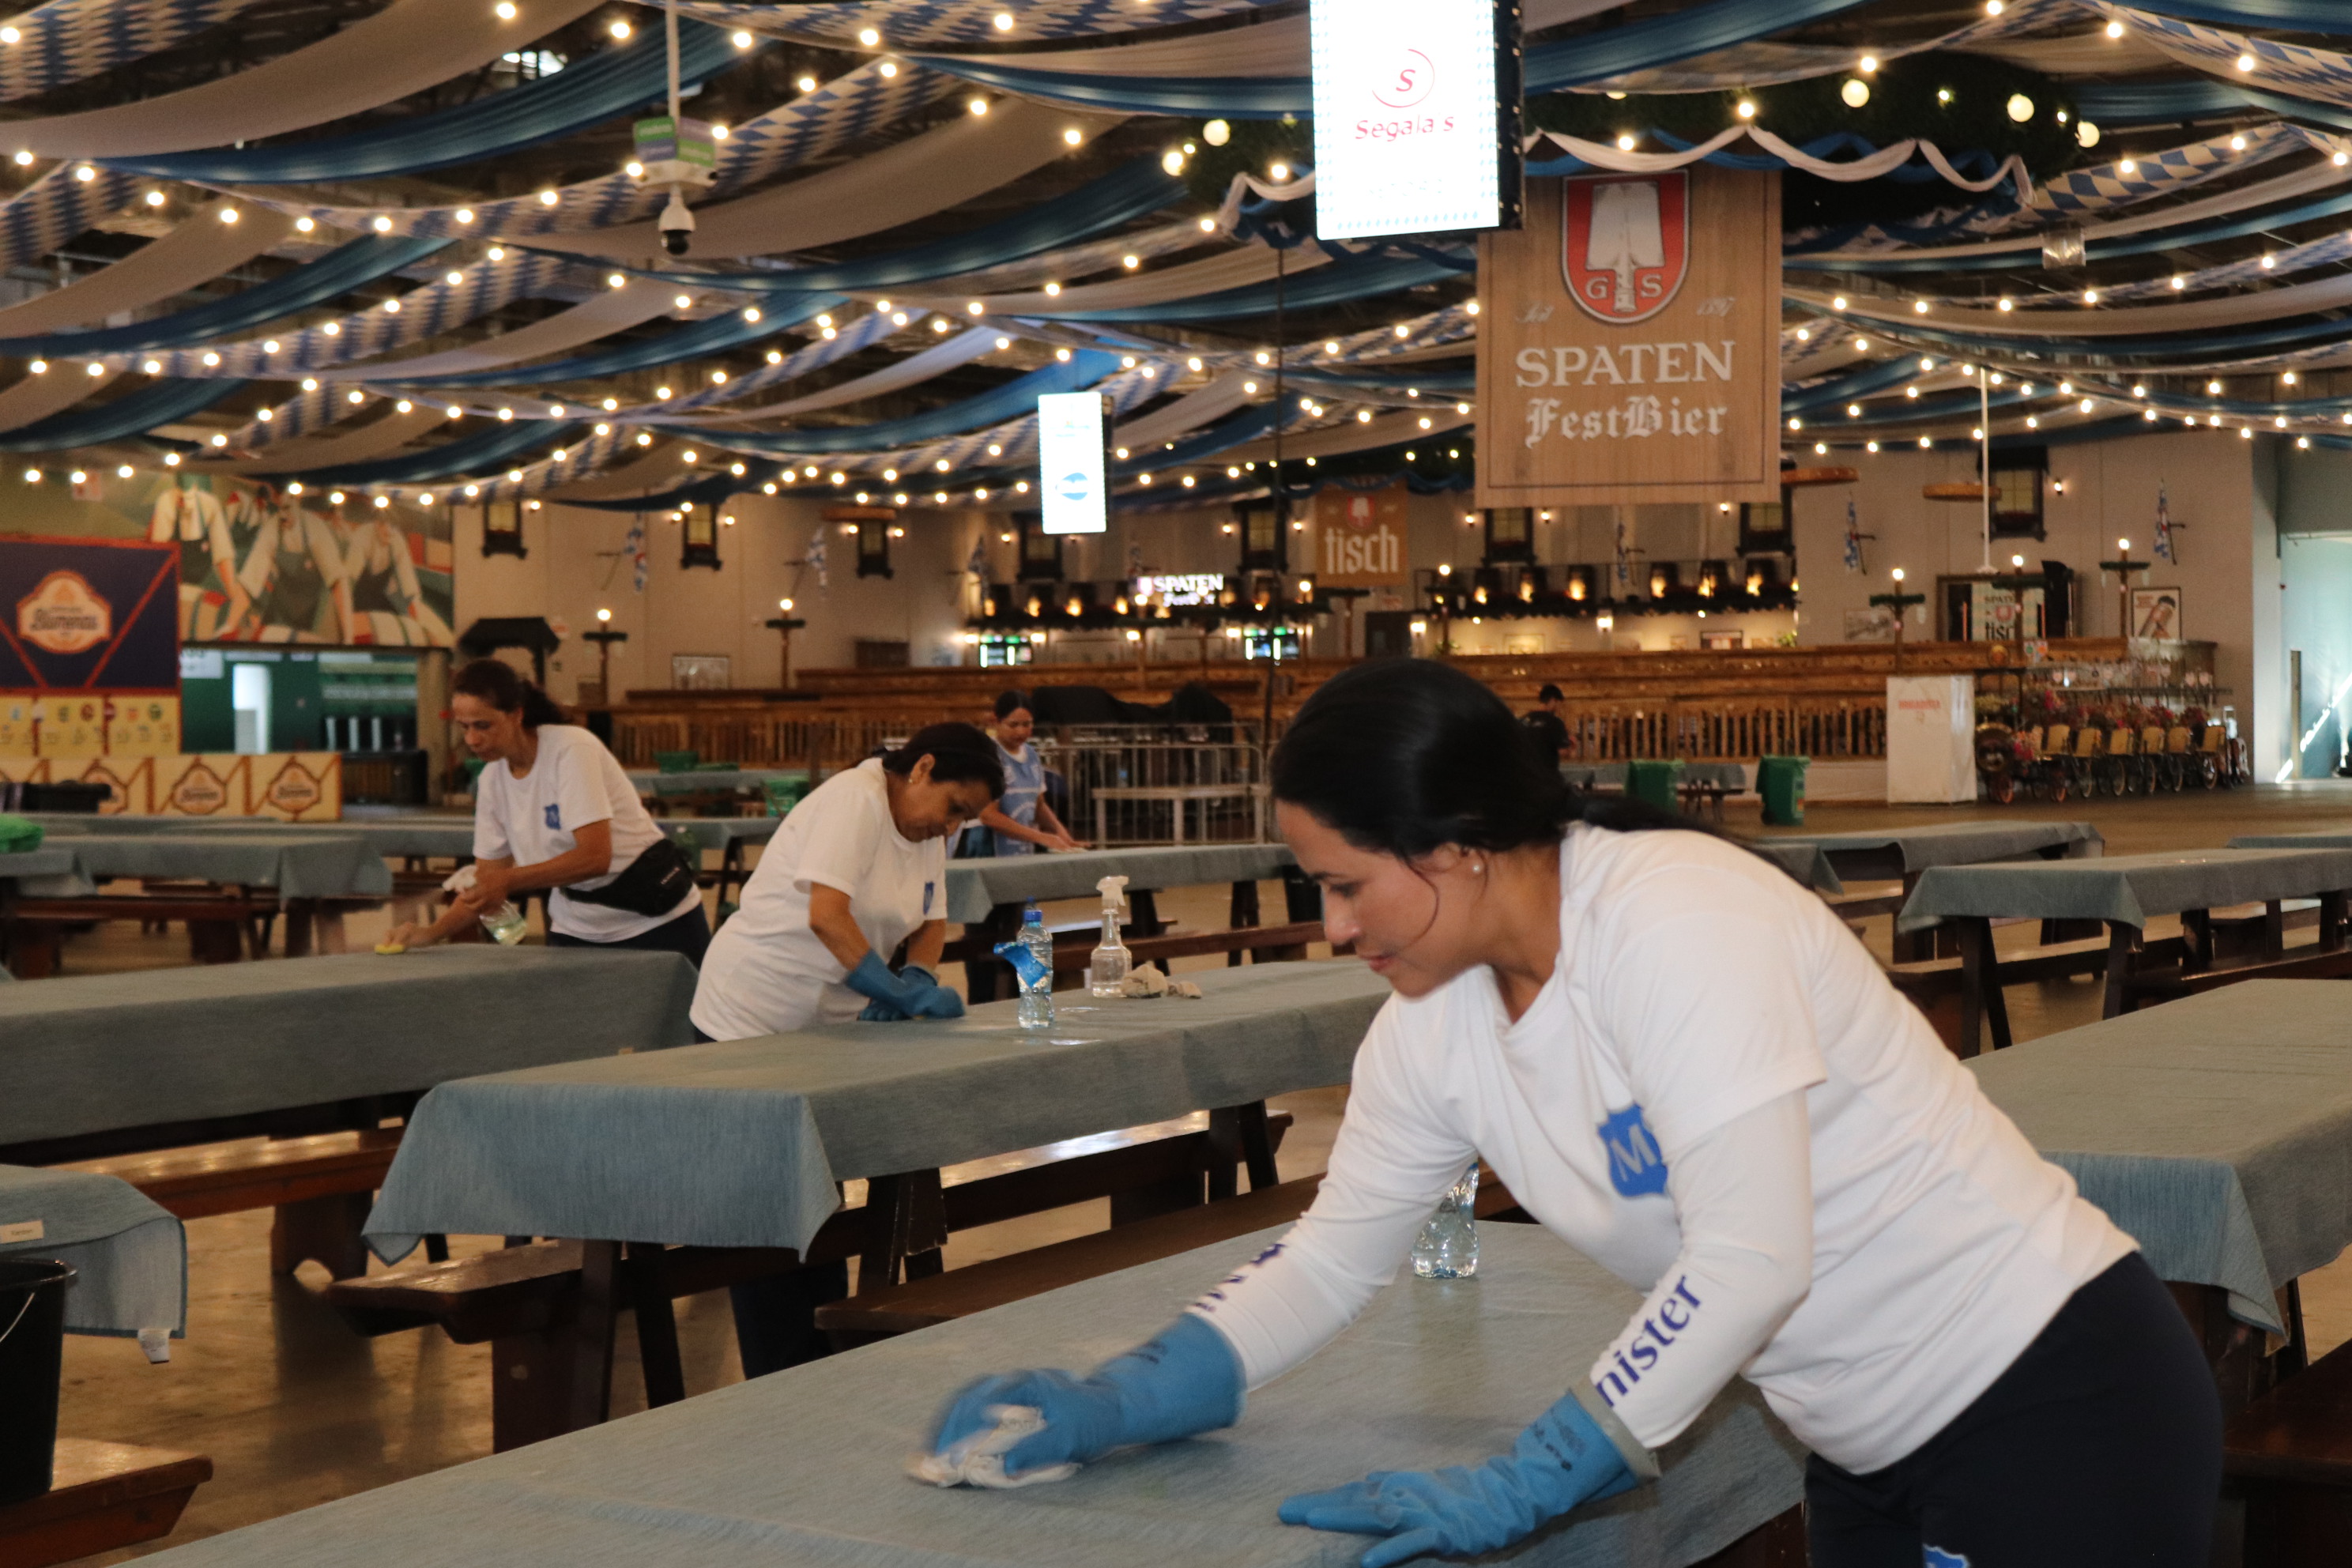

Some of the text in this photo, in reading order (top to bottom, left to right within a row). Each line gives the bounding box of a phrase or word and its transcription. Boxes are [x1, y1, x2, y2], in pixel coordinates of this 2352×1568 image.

[1396, 69, 1416, 92] S
[1585, 273, 1663, 300] G S
[1515, 340, 1736, 387] SPATEN
[1525, 394, 1728, 449] FestBier
[1325, 523, 1399, 575] tisch
[1153, 573, 1224, 592] SPATEN
[1610, 1123, 1657, 1182] M
